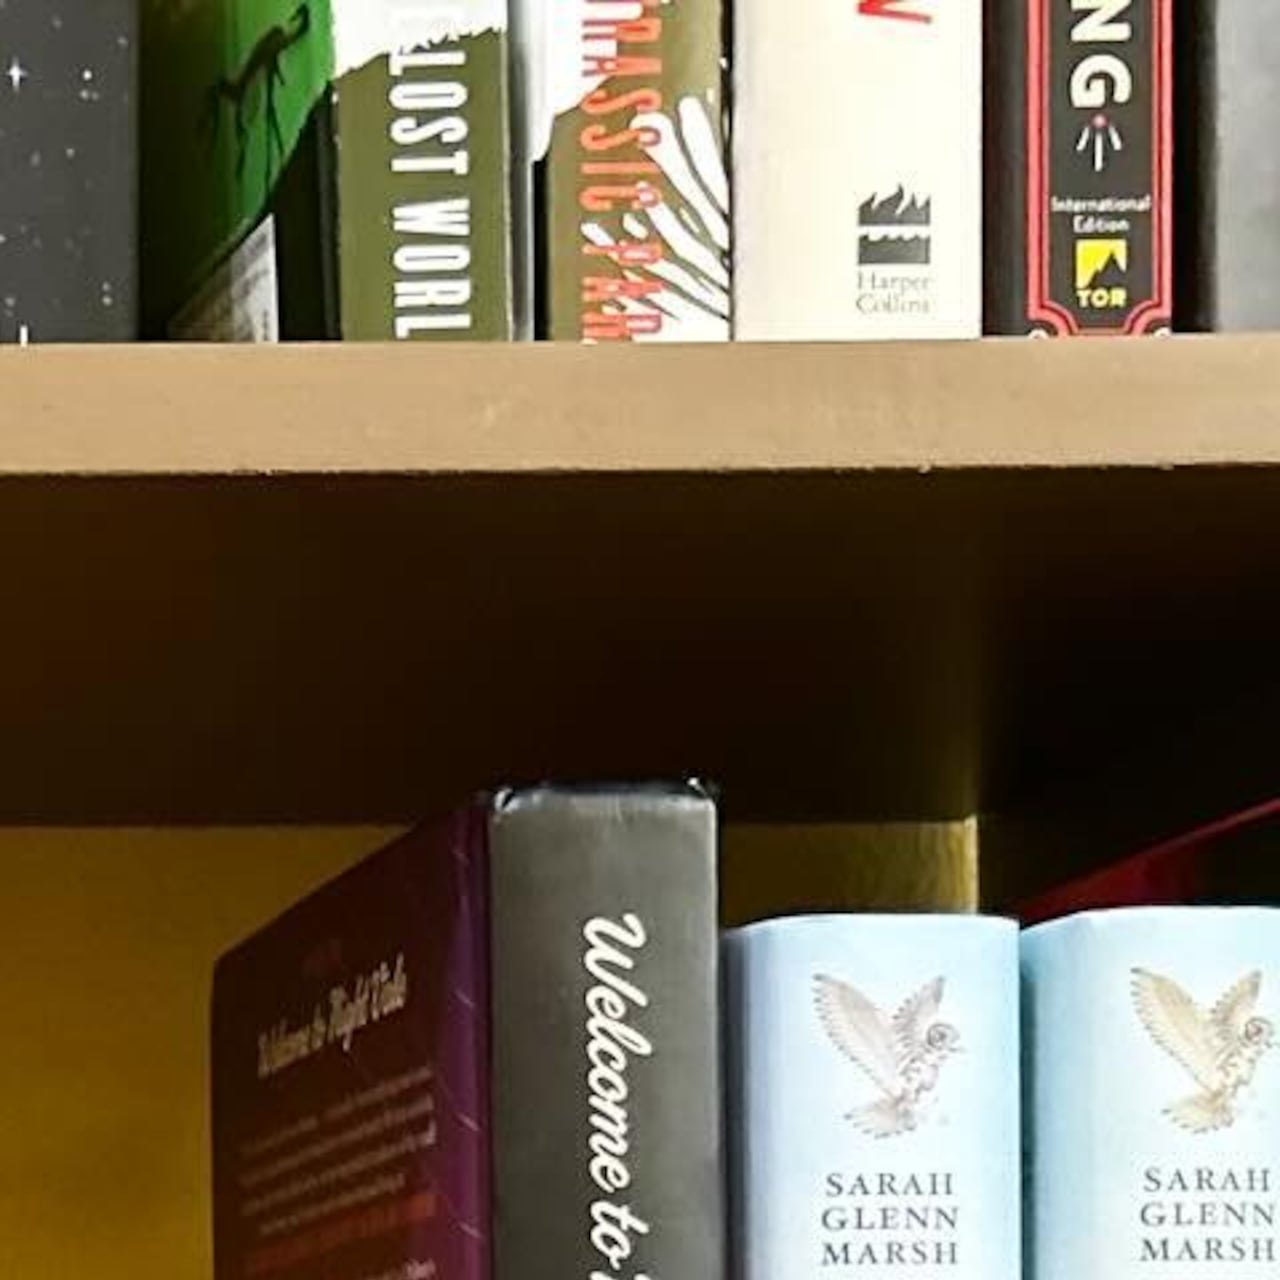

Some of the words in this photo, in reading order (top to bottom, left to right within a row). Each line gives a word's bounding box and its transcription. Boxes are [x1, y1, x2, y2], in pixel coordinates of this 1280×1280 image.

[389, 51, 470, 176] LOST
[1050, 194, 1152, 213] International
[1073, 215, 1130, 234] Edition
[855, 272, 933, 294] Harper
[855, 293, 931, 315] Collins
[1075, 289, 1127, 307] TOR
[581, 911, 653, 1193] Welcome
[824, 1172, 955, 1198] SARAH
[1142, 1167, 1271, 1194] SARAH
[819, 1206, 959, 1231] GLENN
[1139, 1202, 1277, 1228] GLENN
[587, 1198, 650, 1272] to
[819, 1239, 959, 1267] MARSH
[1138, 1235, 1277, 1264] MARSH
